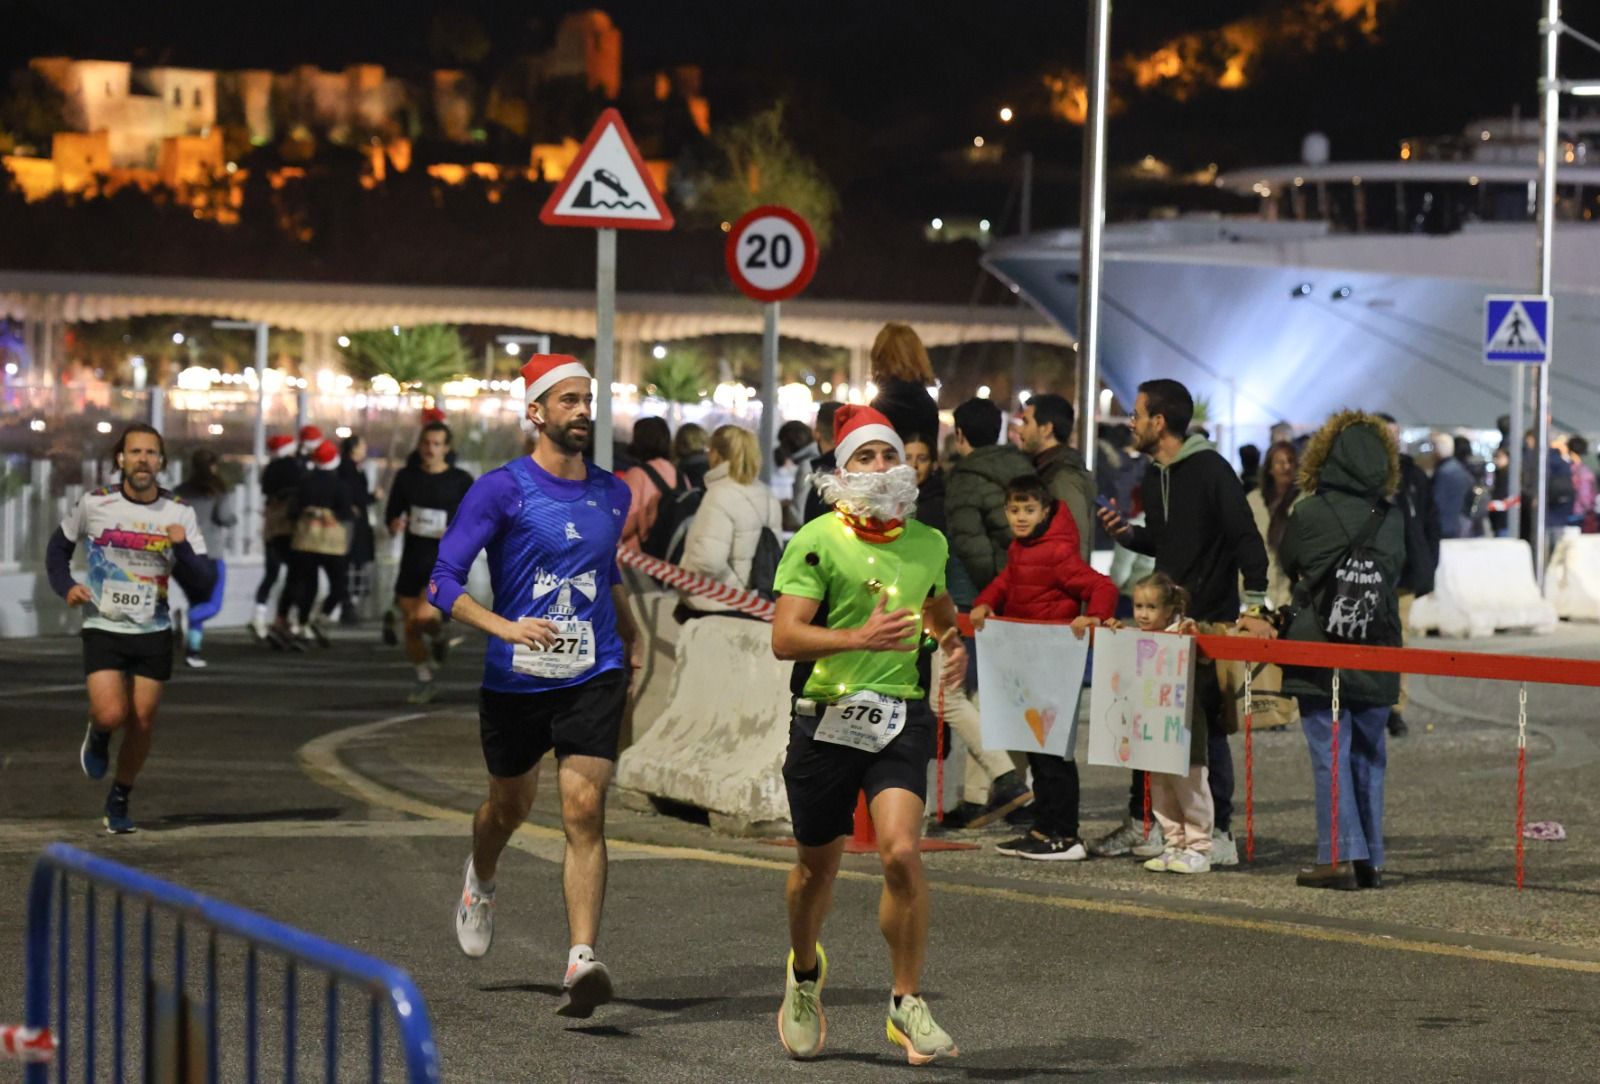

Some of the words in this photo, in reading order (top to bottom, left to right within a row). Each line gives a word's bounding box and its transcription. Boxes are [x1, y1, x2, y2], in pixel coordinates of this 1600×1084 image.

[746, 234, 791, 268] 20
[112, 592, 140, 605] 580
[841, 705, 883, 725] 576
